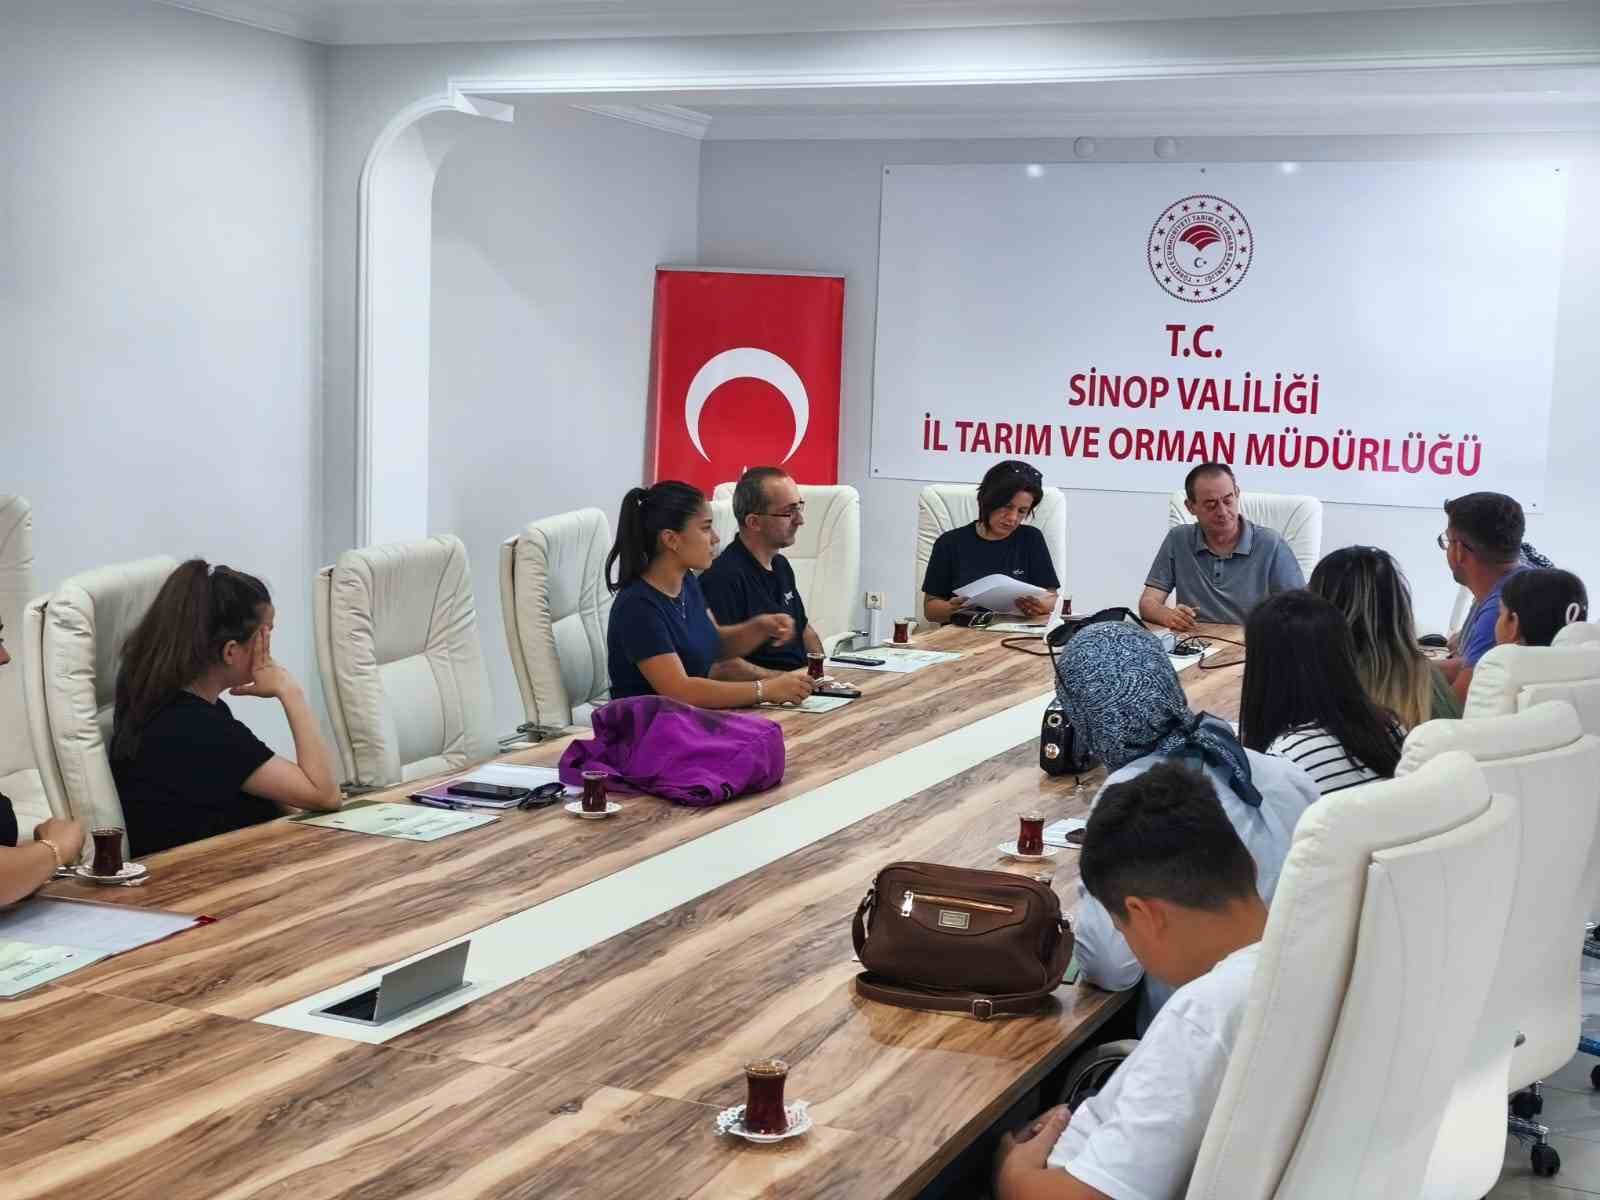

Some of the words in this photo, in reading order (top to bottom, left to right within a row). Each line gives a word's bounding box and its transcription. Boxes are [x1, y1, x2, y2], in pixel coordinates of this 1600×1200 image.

[1166, 324, 1223, 359] T.C.
[1068, 367, 1170, 411] SİNOP
[1177, 371, 1320, 416] VALİLİĞİ
[922, 412, 948, 453] İL
[955, 420, 1053, 456] TARIM
[1060, 426, 1099, 459] VE
[1108, 427, 1237, 465] ORMAN
[1244, 426, 1483, 477] MÜDÜRLÜĞÜ
